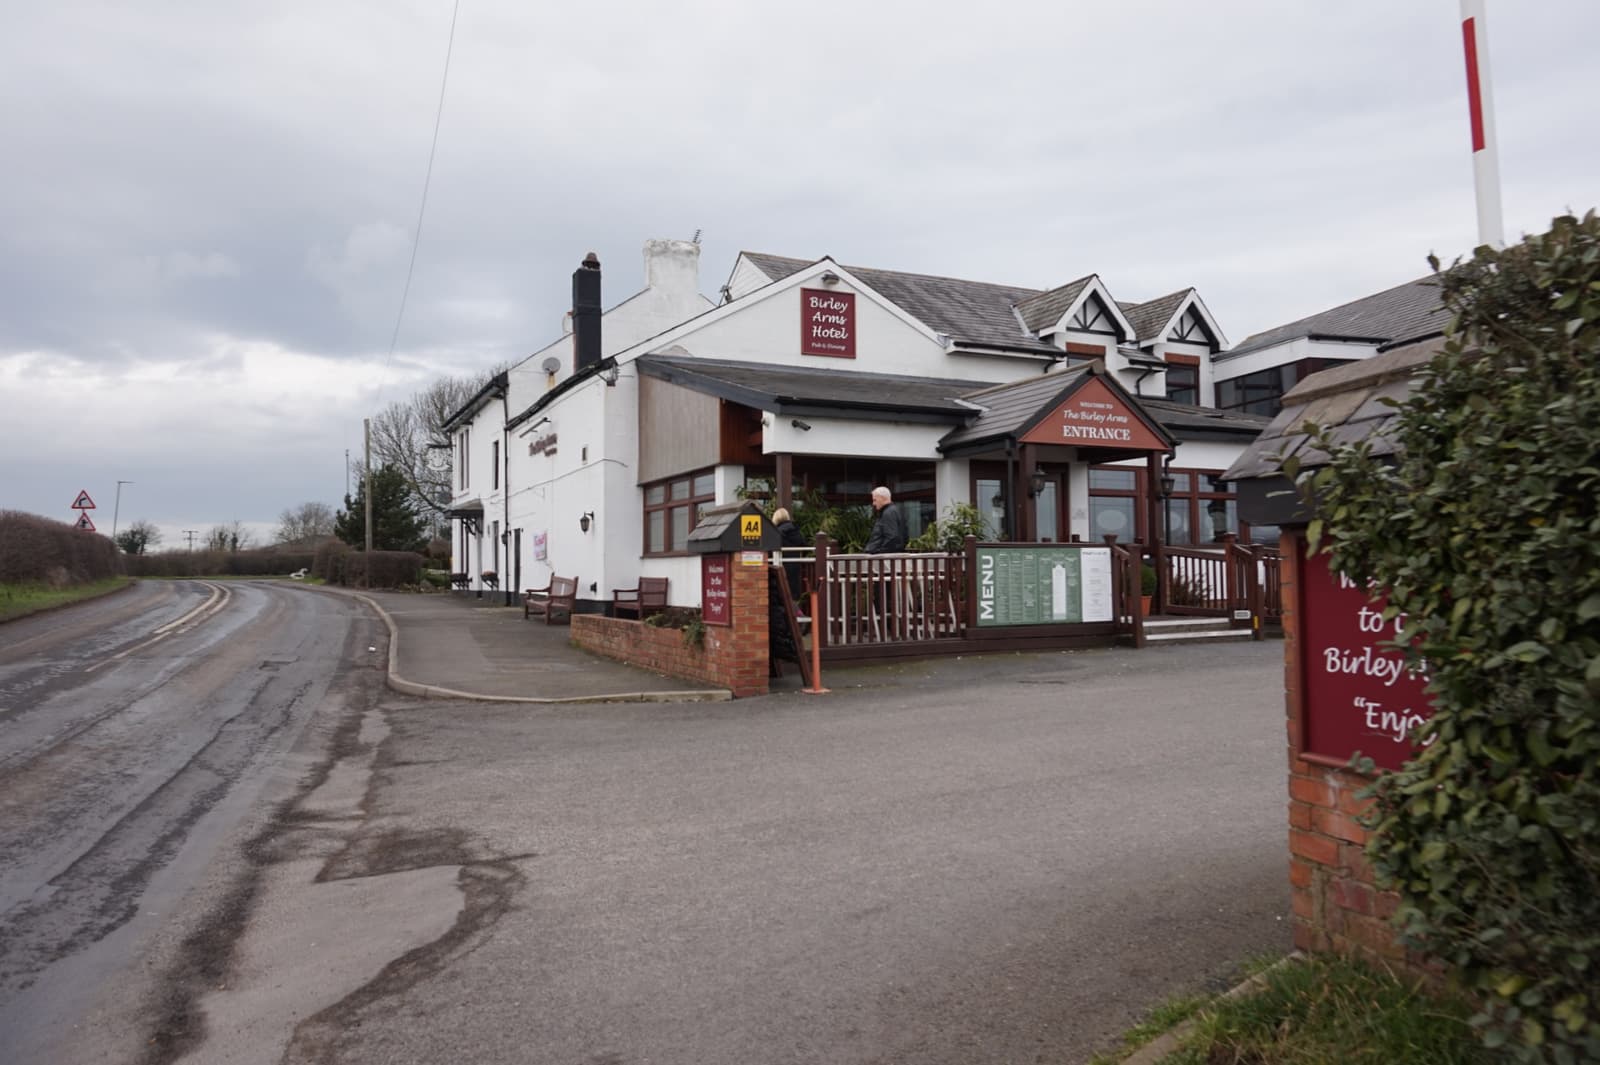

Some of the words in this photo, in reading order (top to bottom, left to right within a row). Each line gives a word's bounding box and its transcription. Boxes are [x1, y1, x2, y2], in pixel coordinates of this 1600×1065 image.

[809, 296, 848, 313] Birley
[812, 311, 847, 325] Arms
[812, 325, 848, 339] Hotel
[1063, 409, 1080, 419] The
[1080, 410, 1105, 423] Birley
[1107, 413, 1128, 423] Arms
[1063, 425, 1131, 440] ENTRANCE
[744, 521, 759, 533] AA
[980, 554, 994, 620] MENU
[1358, 606, 1384, 632] to
[1323, 647, 1404, 686] Birley
